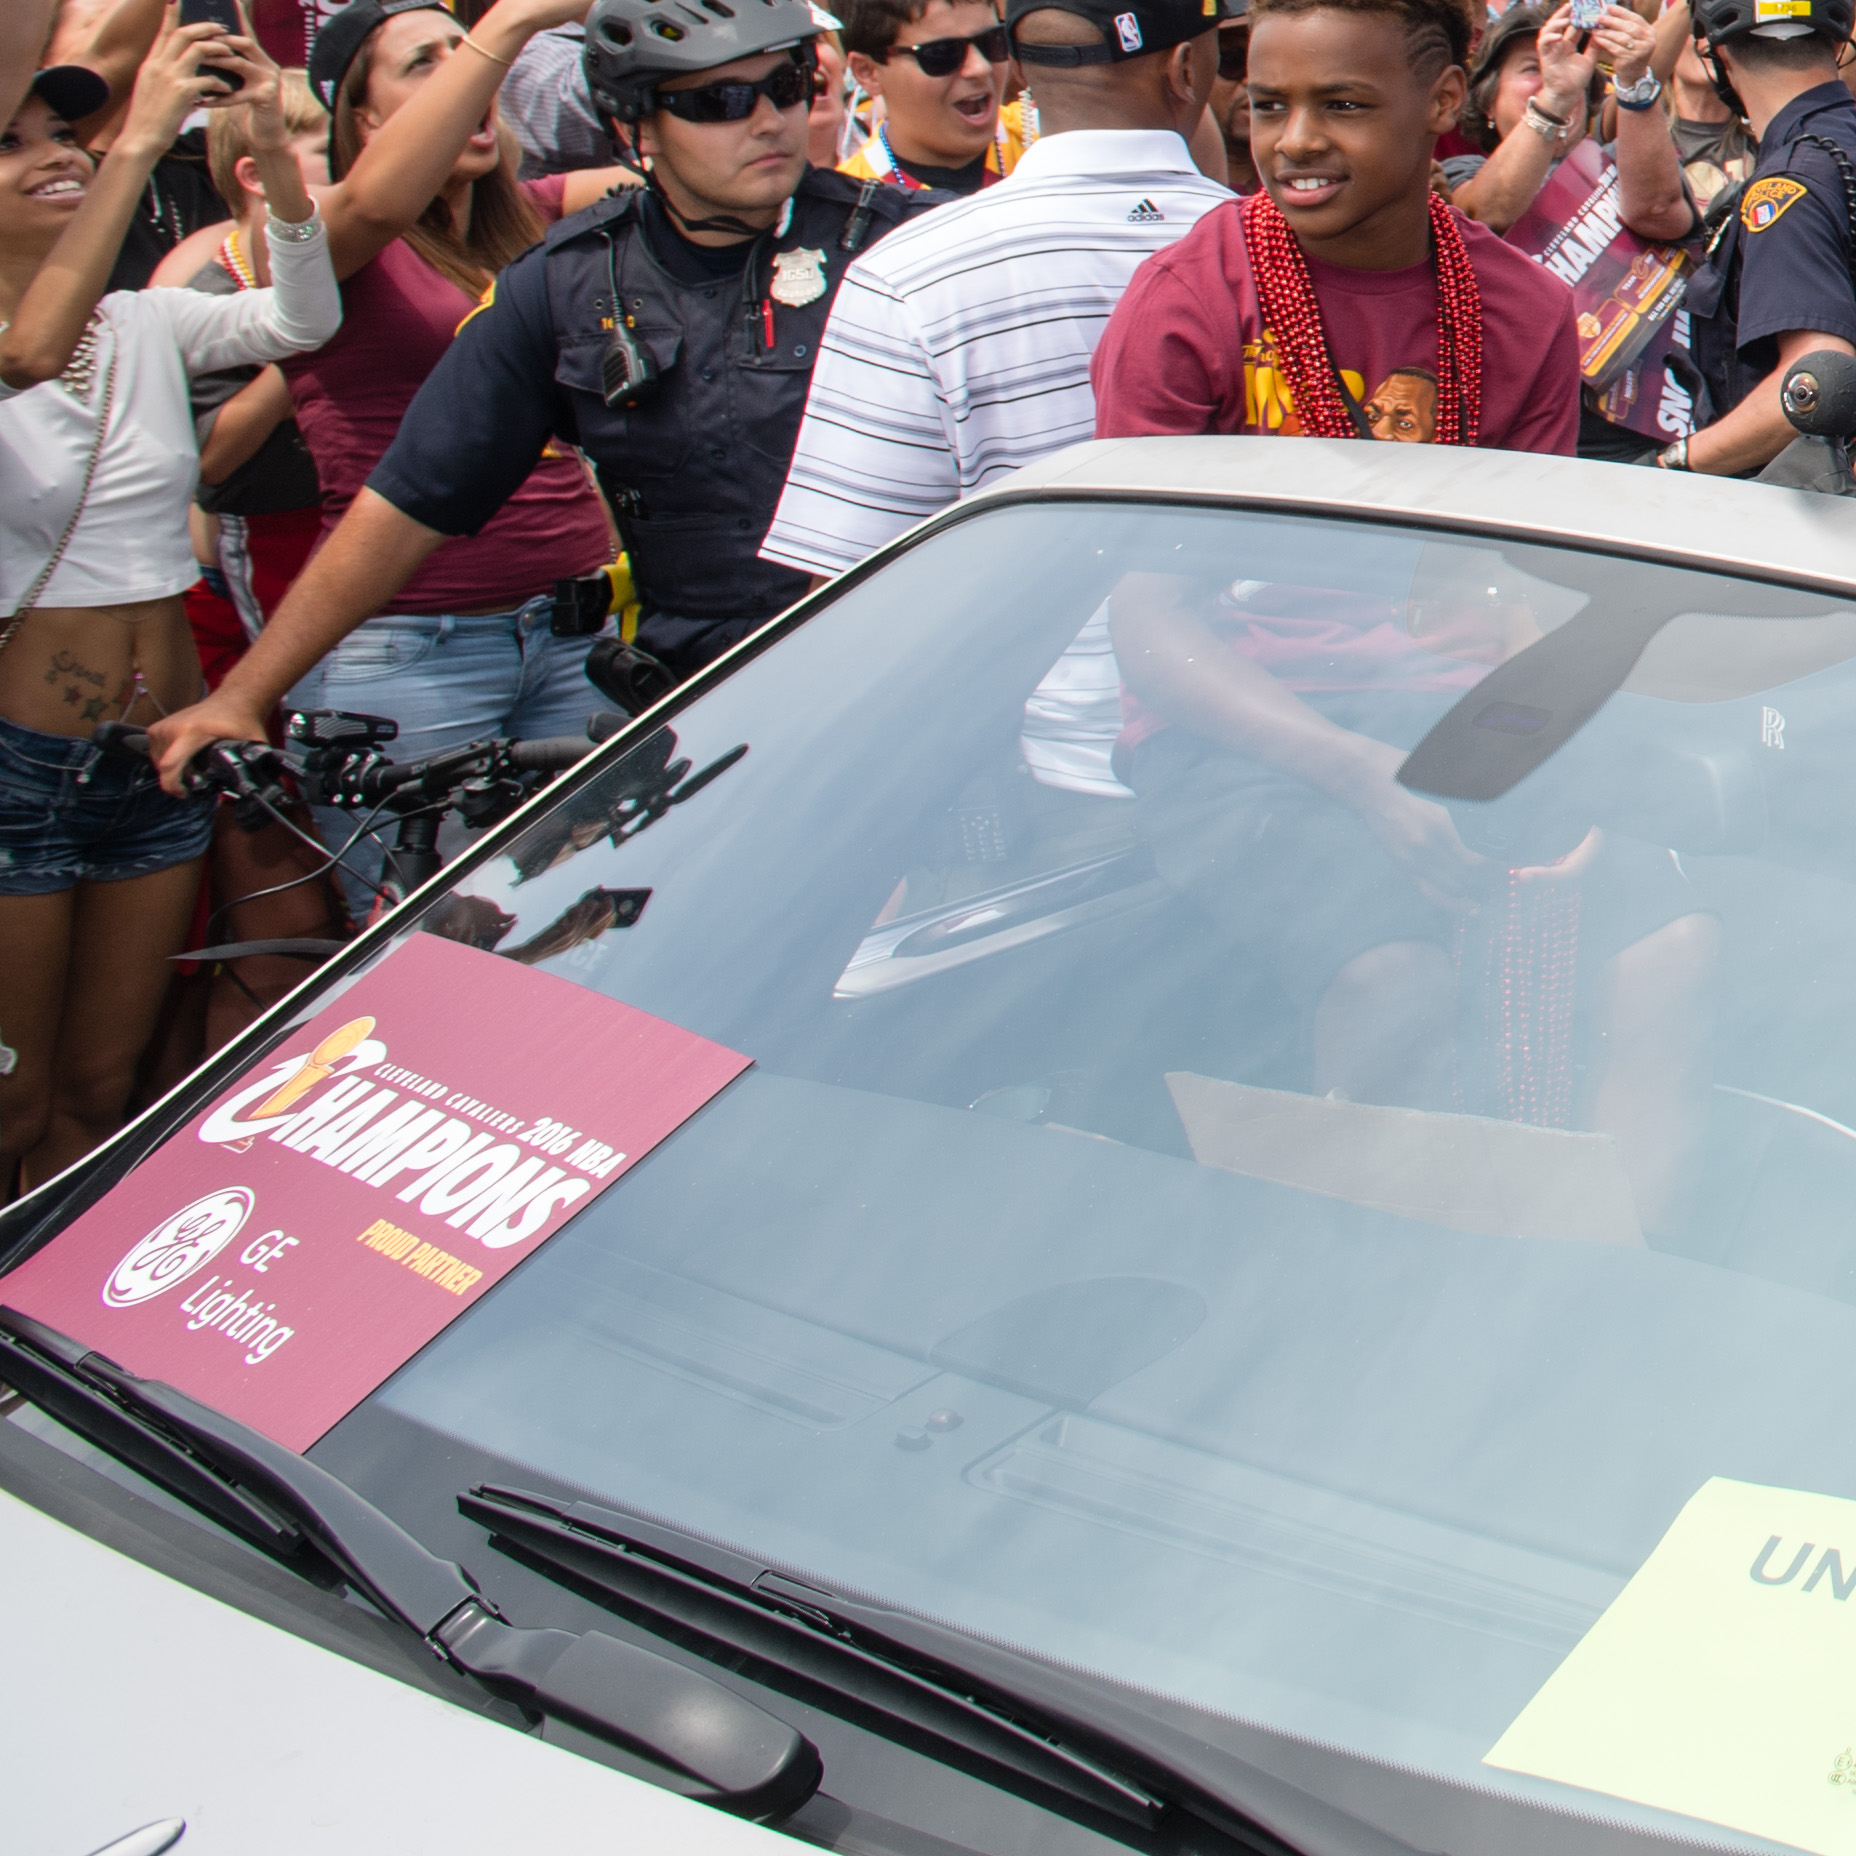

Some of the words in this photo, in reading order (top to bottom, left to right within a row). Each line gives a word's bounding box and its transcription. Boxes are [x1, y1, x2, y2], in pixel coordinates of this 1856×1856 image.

[1127, 212, 1165, 223] adidas
[197, 1039, 592, 1250] CHAMPIONS
[374, 1063, 449, 1100] CLEVELAND
[444, 1092, 525, 1135] CAVALIERS
[516, 1116, 583, 1156] 2016
[564, 1140, 627, 1179] NBA
[239, 1229, 300, 1273] GE
[355, 1218, 421, 1263] PROUD
[401, 1241, 483, 1296] PARTNER
[180, 1274, 295, 1365] Lighting
